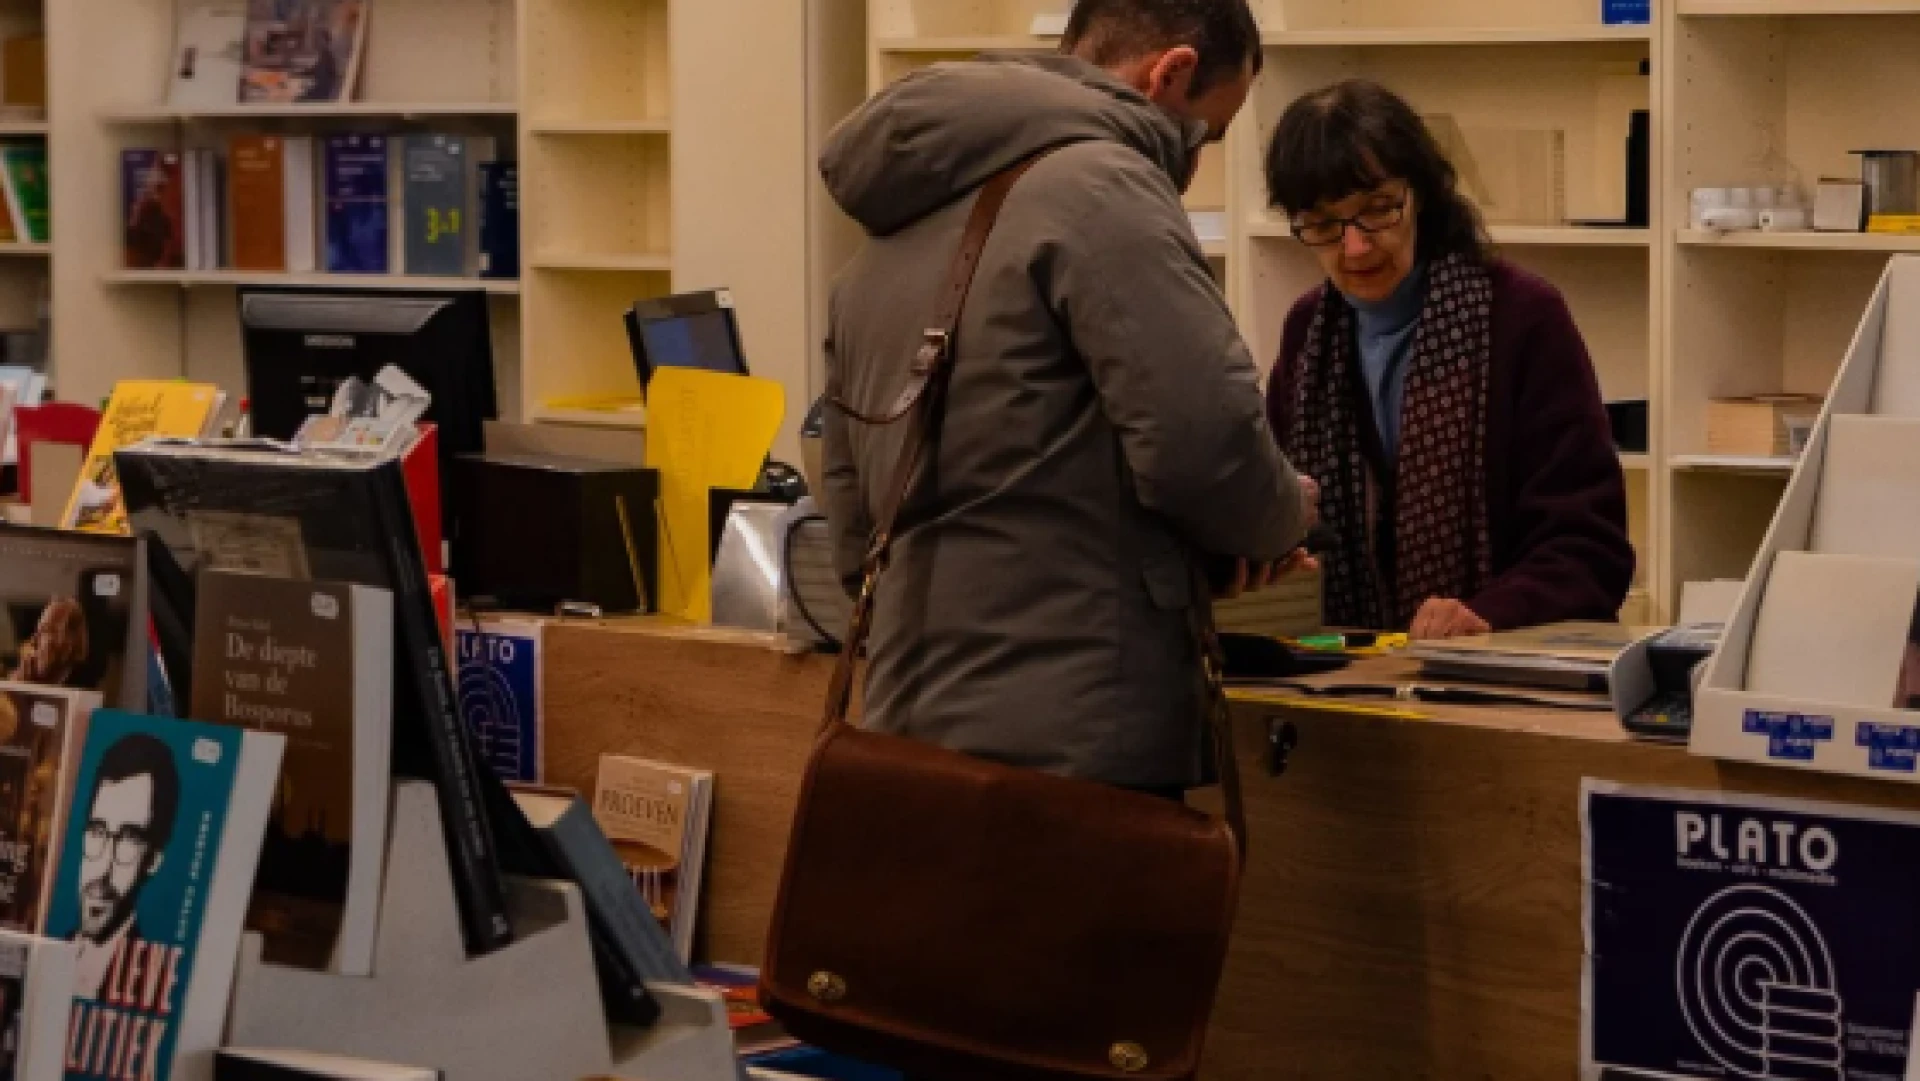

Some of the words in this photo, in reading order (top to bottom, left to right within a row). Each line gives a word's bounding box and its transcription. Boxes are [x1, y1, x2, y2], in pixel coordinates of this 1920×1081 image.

[225, 632, 253, 661] De
[259, 635, 317, 675] diepte
[225, 670, 261, 692] van
[266, 666, 288, 695] de
[1675, 811, 1838, 871] PLATO
[106, 937, 184, 1017] LEVE
